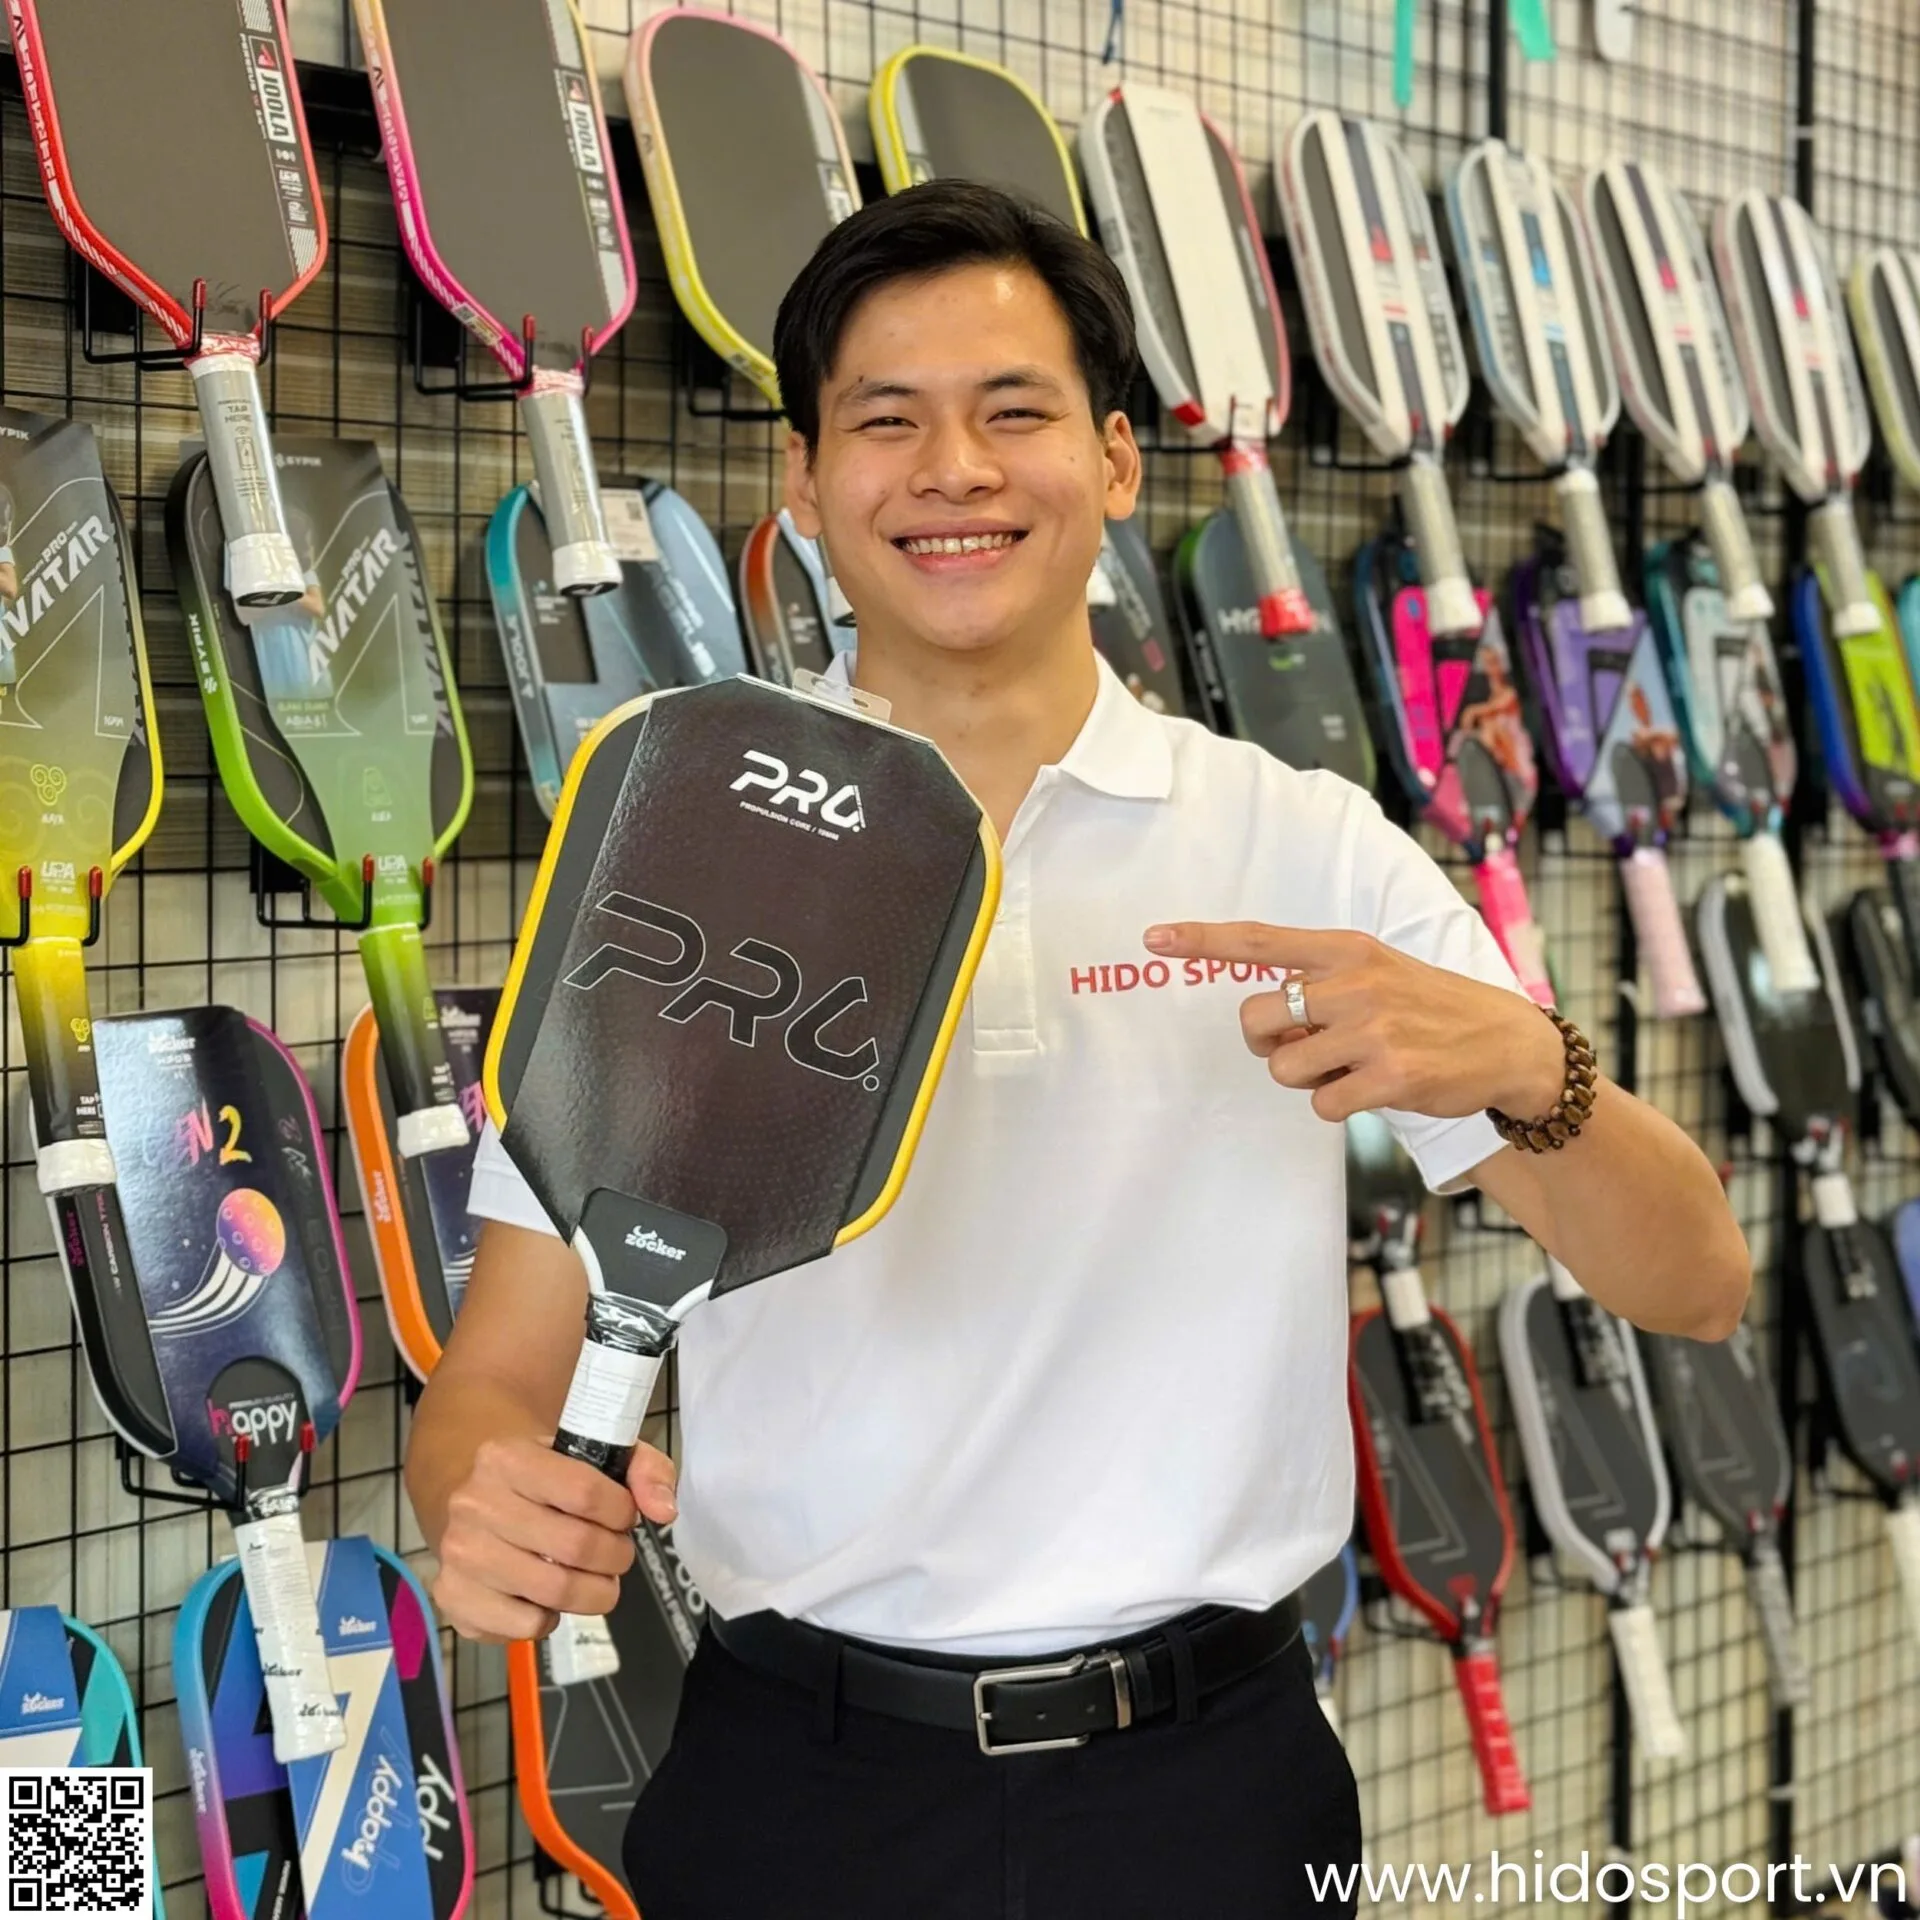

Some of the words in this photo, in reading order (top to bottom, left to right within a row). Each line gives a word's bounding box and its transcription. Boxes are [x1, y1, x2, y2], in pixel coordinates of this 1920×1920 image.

[261, 73, 290, 137] JOOLA
[574, 109, 598, 166] JOOLA
[0, 426, 30, 441] YPIK
[41, 531, 68, 563] PRO
[341, 547, 364, 581] PRO
[308, 528, 398, 687] AVATAR
[188, 613, 211, 674] SYPIK
[505, 614, 531, 681] JOOLA
[740, 801, 789, 823] PROPULSION
[789, 818, 812, 832] CORE
[40, 861, 76, 879] UPA
[378, 855, 407, 871] UPA
[1070, 960, 1171, 994] HIDO
[76, 1107, 97, 1116] HERE
[80, 1096, 95, 1105] TAP
[102, 1223, 119, 1275] CARBON
[625, 1228, 687, 1260] zocker
[206, 1398, 298, 1447] happy
[633, 1527, 674, 1601] ARBON
[341, 1754, 403, 1871] happy
